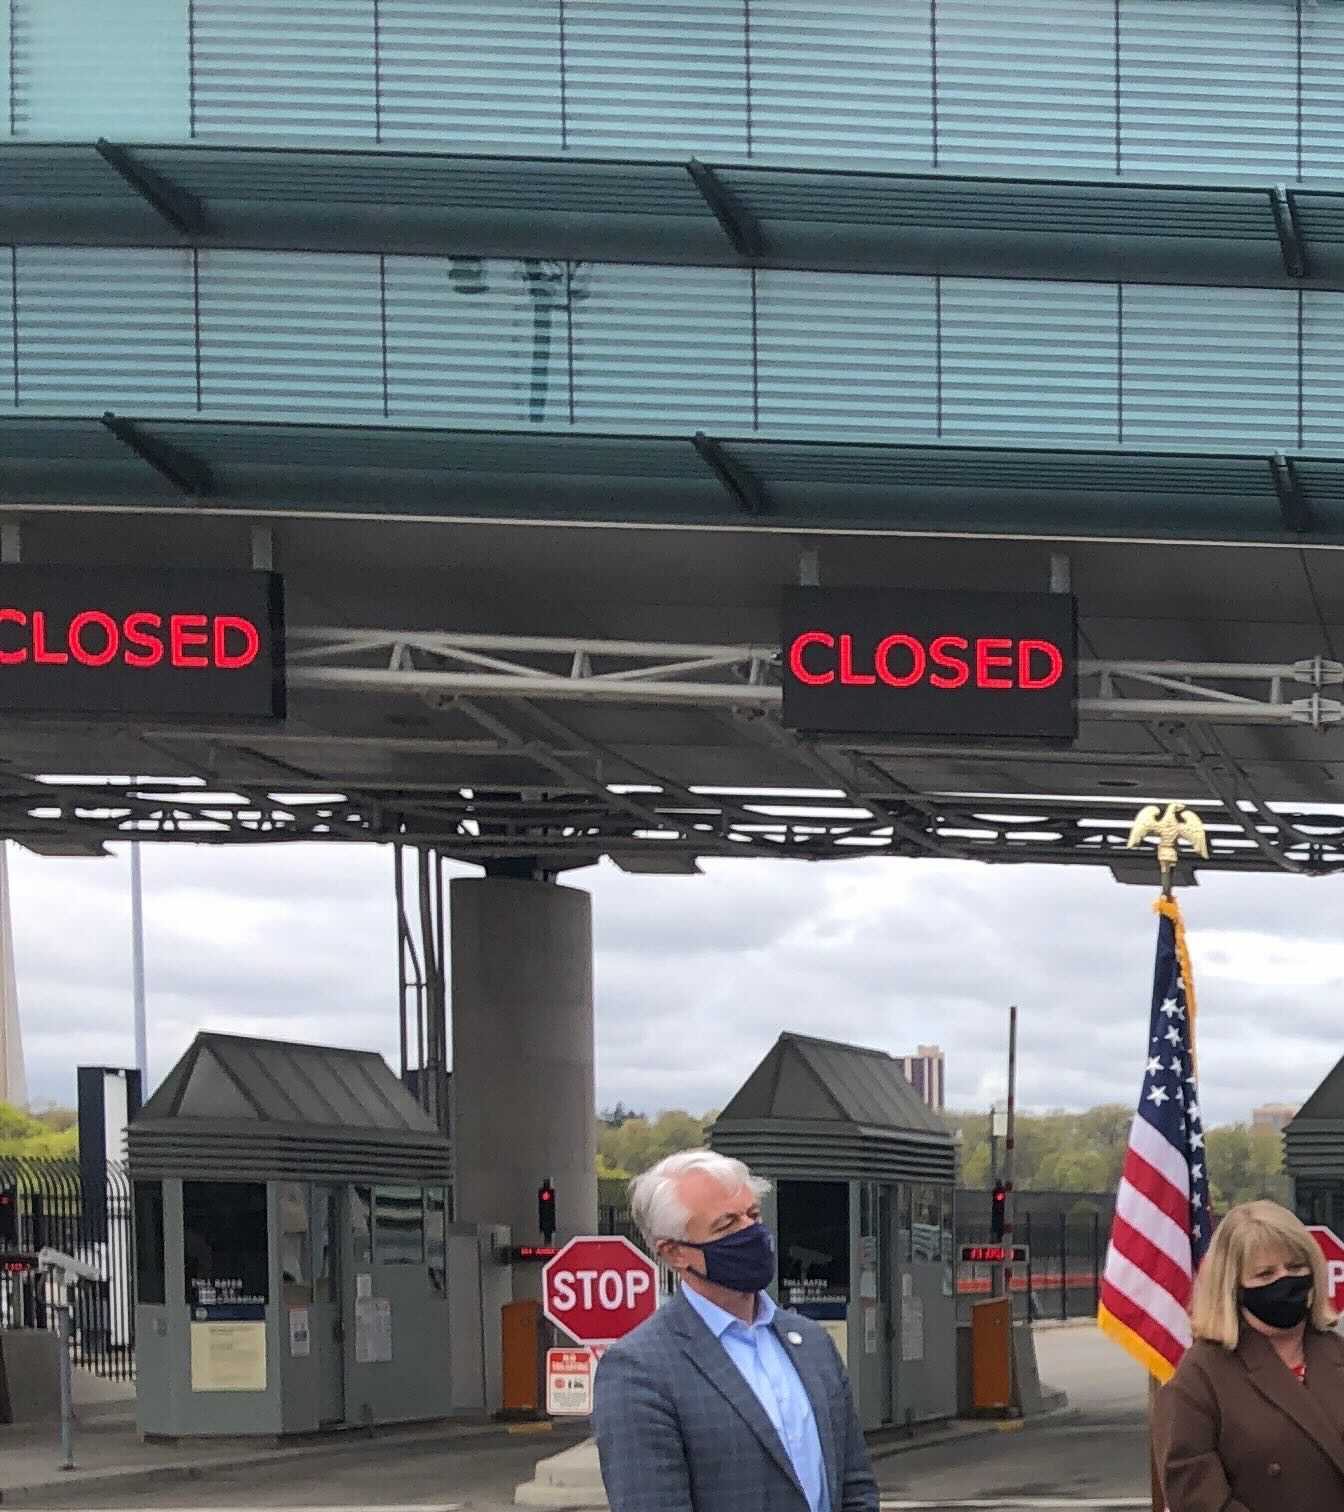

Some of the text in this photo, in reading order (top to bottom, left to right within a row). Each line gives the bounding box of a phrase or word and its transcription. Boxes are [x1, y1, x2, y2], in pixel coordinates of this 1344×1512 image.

[0, 608, 260, 669] CLOSED
[789, 632, 1063, 689] CLOSED
[552, 1269, 650, 1311] STOP
